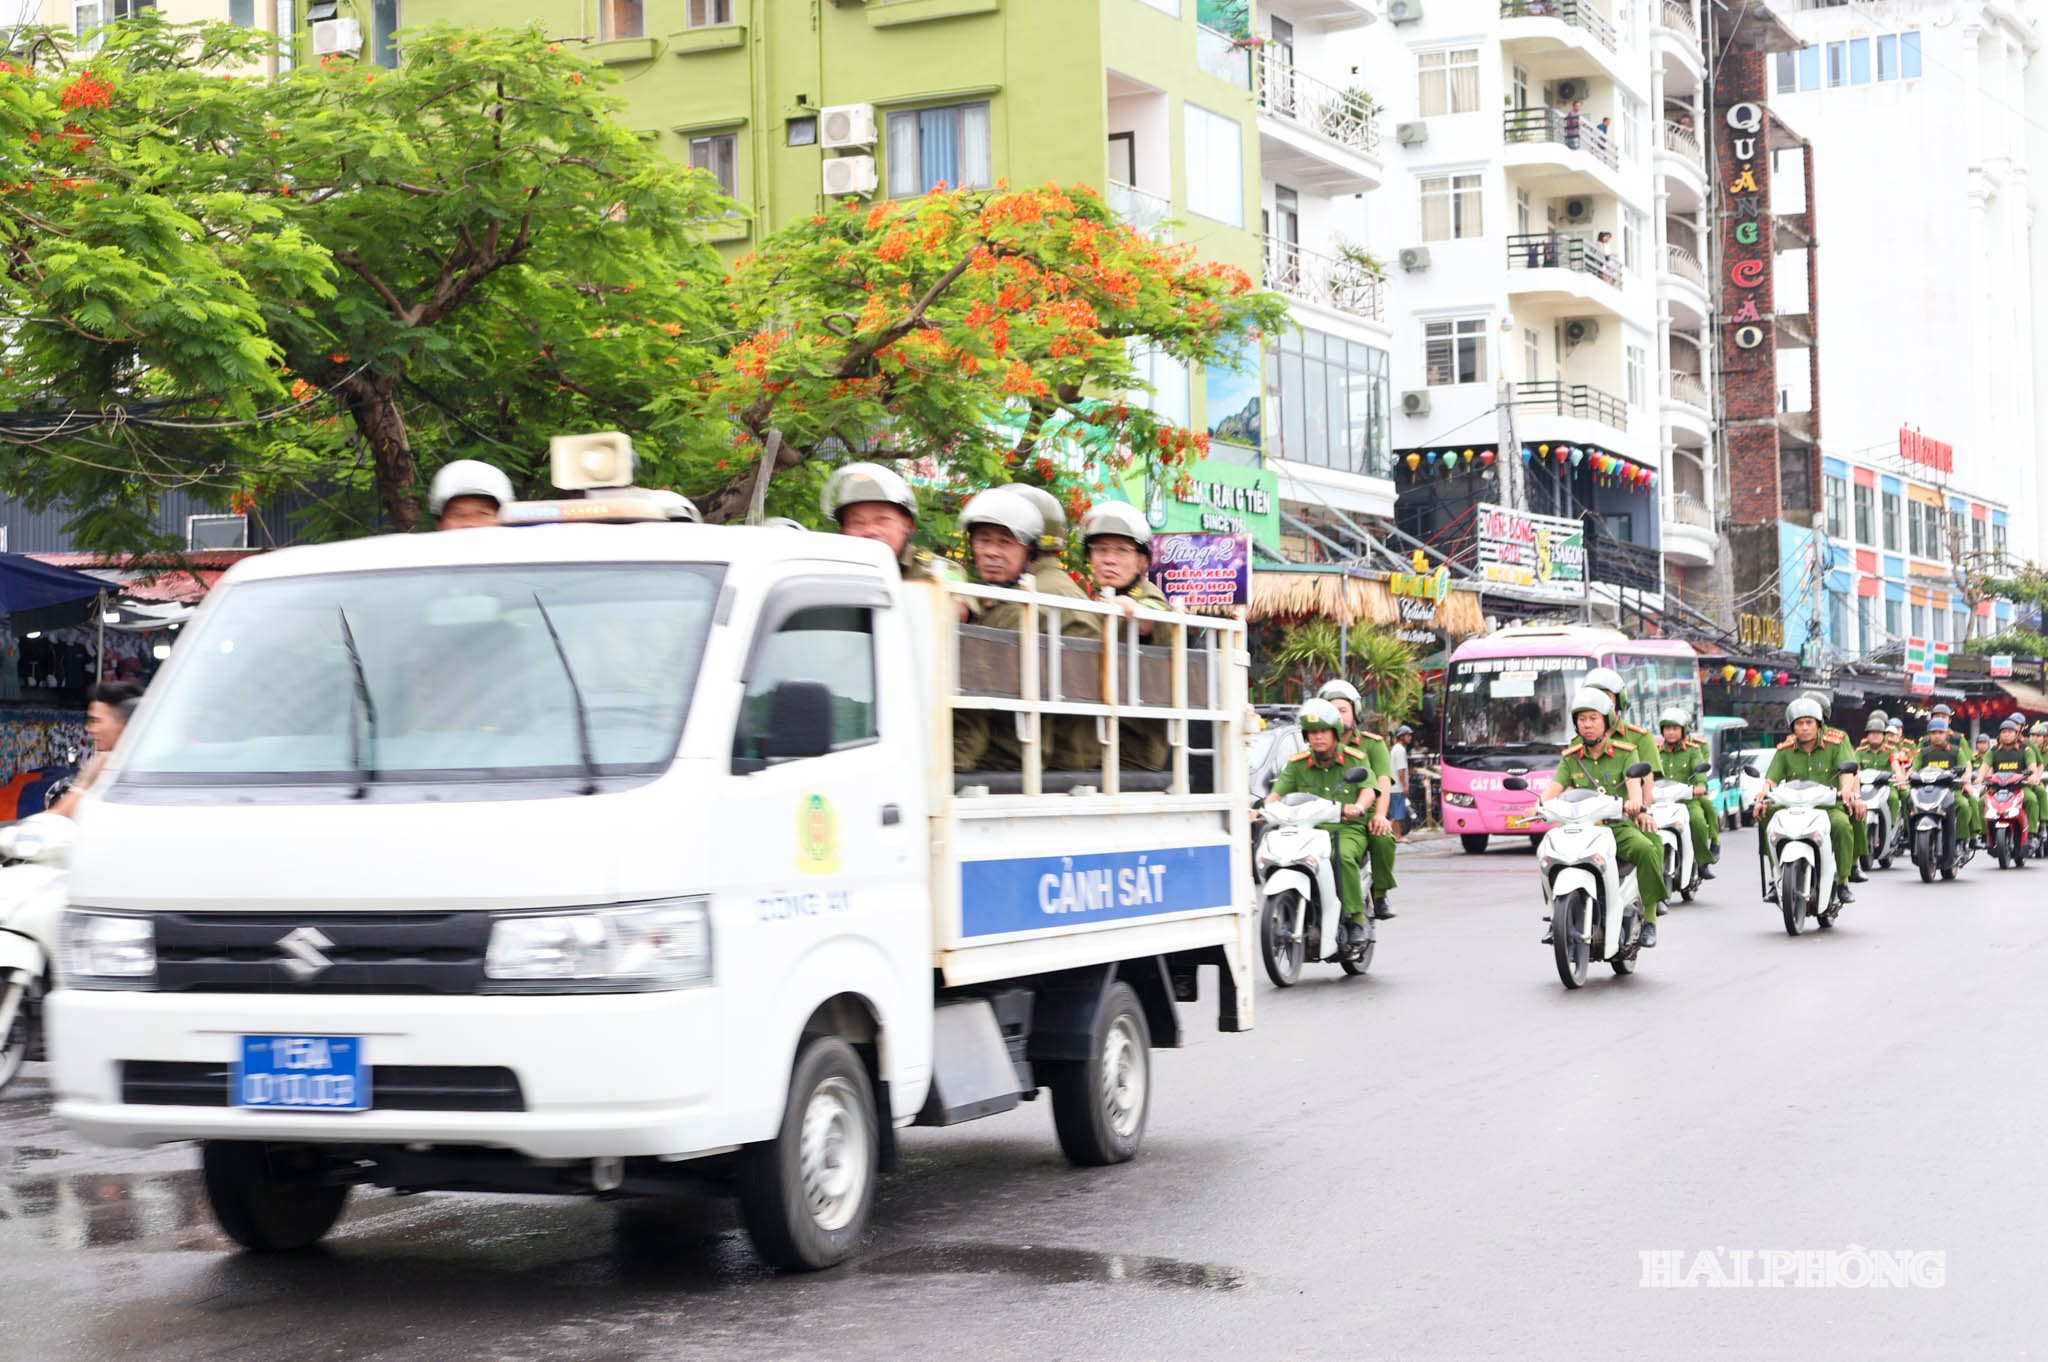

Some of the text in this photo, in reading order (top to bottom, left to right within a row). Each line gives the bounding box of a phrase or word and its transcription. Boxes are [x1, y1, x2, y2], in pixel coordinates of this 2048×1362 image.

[1731, 260, 1764, 349] CÁO
[1201, 513, 1229, 533] SINCE
[1215, 538, 1236, 560] 2
[1205, 569, 1237, 579] XEM
[1166, 581, 1237, 593] PHÁO HOA
[1208, 592, 1234, 605] PHÍ
[1038, 855, 1167, 914] CẢNH SÁT
